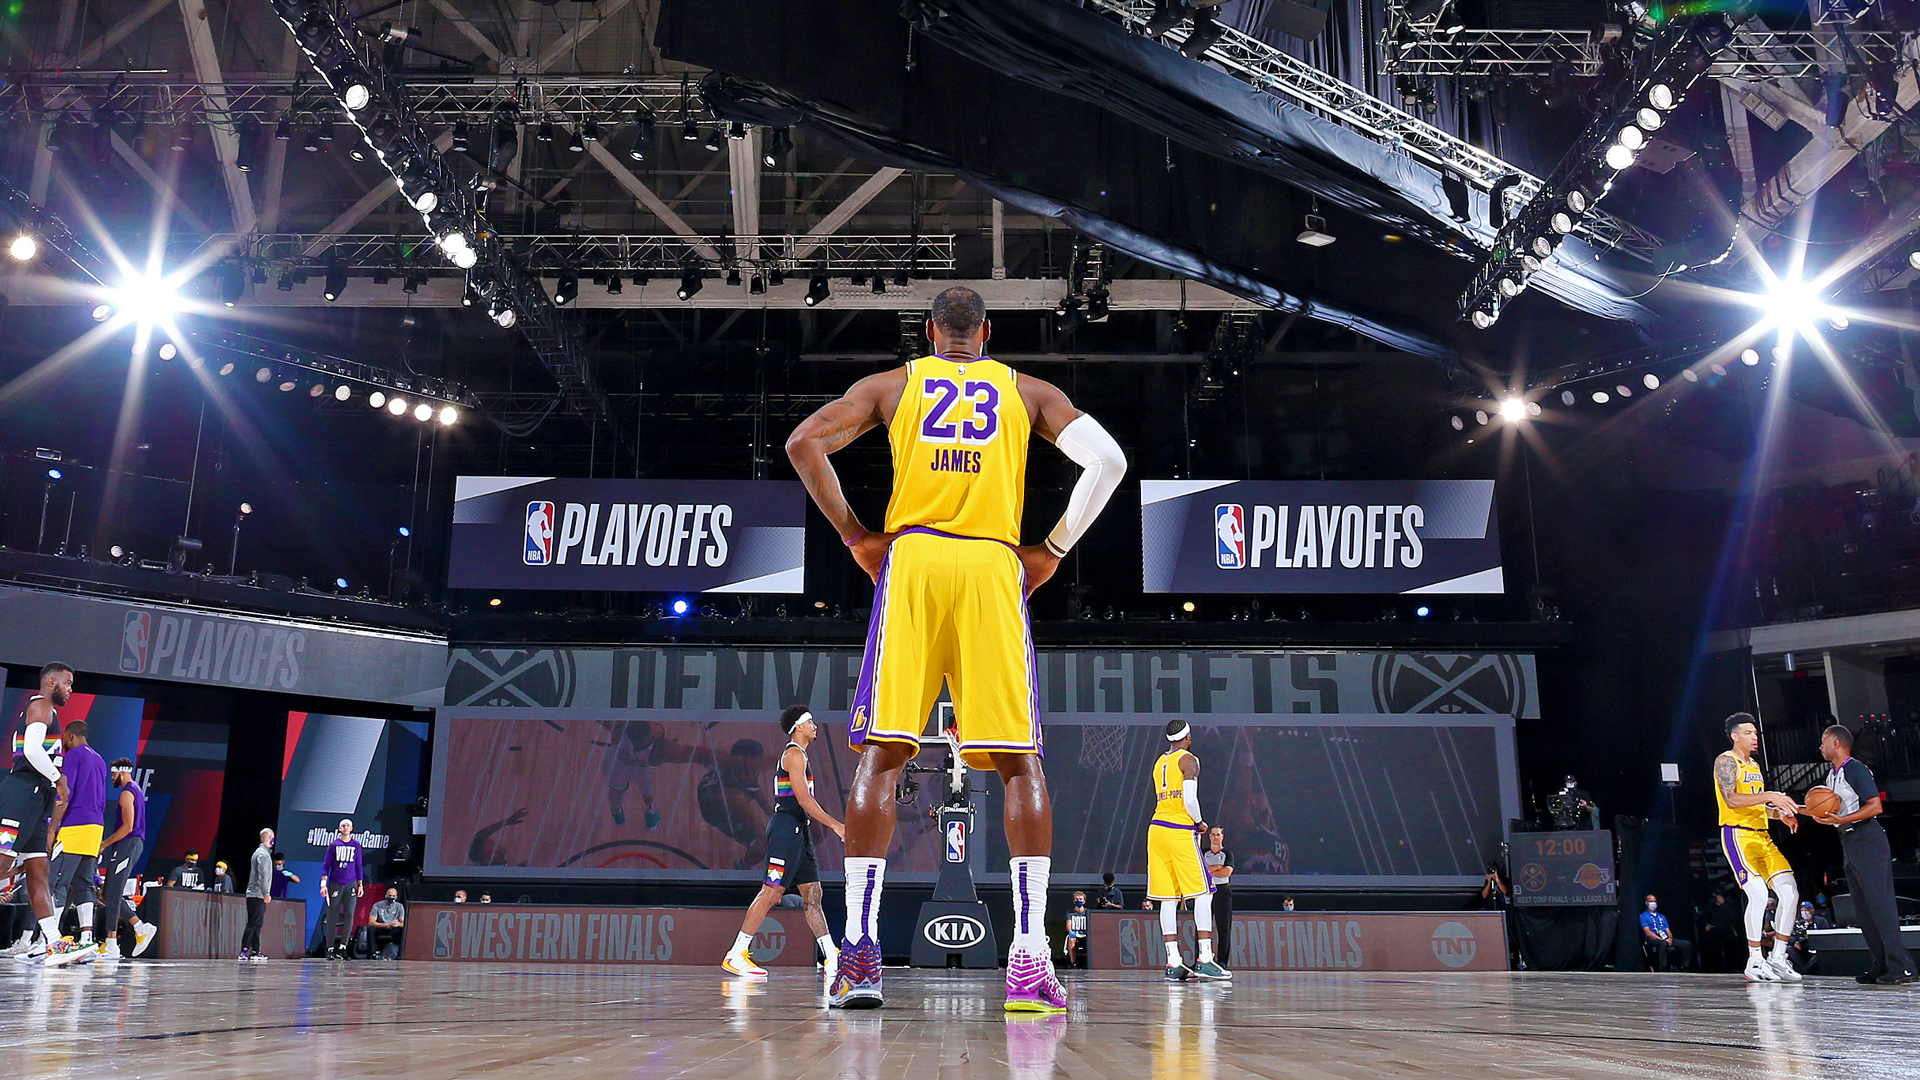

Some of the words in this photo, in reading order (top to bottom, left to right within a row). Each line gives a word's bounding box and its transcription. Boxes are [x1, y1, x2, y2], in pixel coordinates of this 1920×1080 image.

[920, 377, 1001, 446] 23
[931, 448, 981, 473] JAMES
[556, 502, 733, 567] PLAYOFFS
[1250, 504, 1424, 568] PLAYOFFS
[527, 550, 541, 561] NBA
[1220, 553, 1236, 564] NBA
[150, 615, 305, 689] PLAYOFFS
[610, 650, 858, 711] DENVE
[1161, 763, 1169, 790] 1
[335, 845, 356, 862] VOTE
[1535, 838, 1586, 856] 12:00
[1517, 896, 1532, 904] WEST
[1548, 895, 1568, 903] FINALS
[460, 912, 581, 960] WESTERN
[585, 914, 675, 961] FINALS
[753, 931, 786, 950] NT
[935, 922, 976, 941] KIA
[1272, 920, 1363, 968] FINALS
[1432, 937, 1477, 956] TNT
